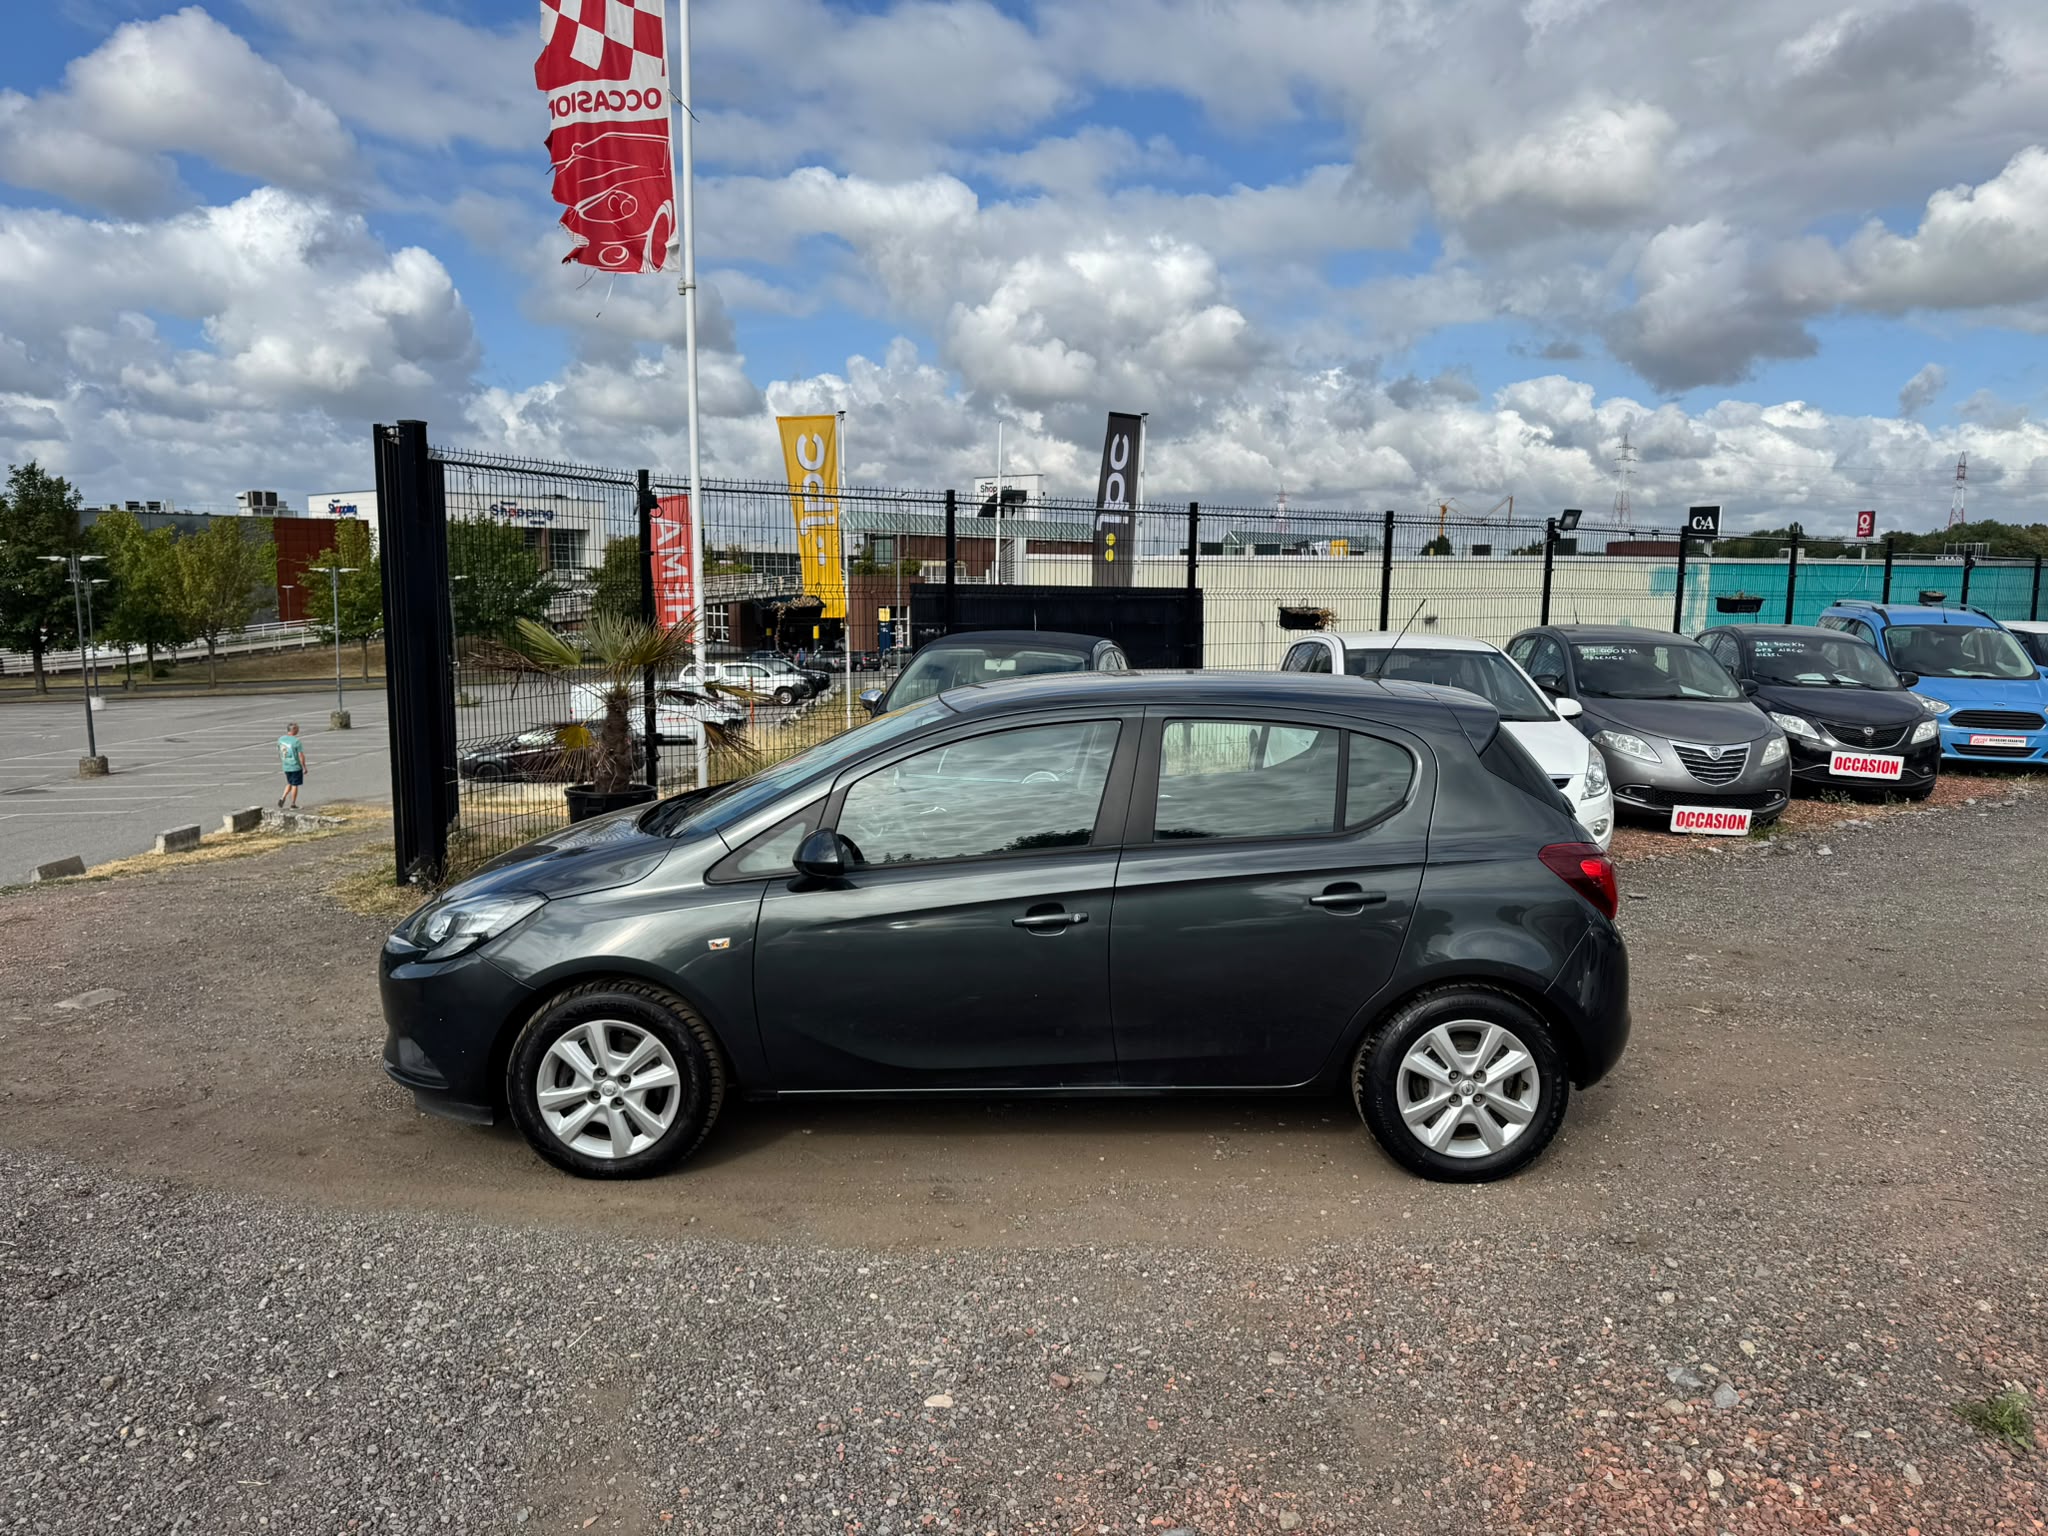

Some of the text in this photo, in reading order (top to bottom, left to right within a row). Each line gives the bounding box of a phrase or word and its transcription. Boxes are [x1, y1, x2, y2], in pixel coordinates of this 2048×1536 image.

[489, 504, 554, 521] Shopping
[1692, 515, 1715, 530] C&A
[1834, 756, 1899, 775] OCCASION
[1675, 811, 1747, 830] OCCASION
